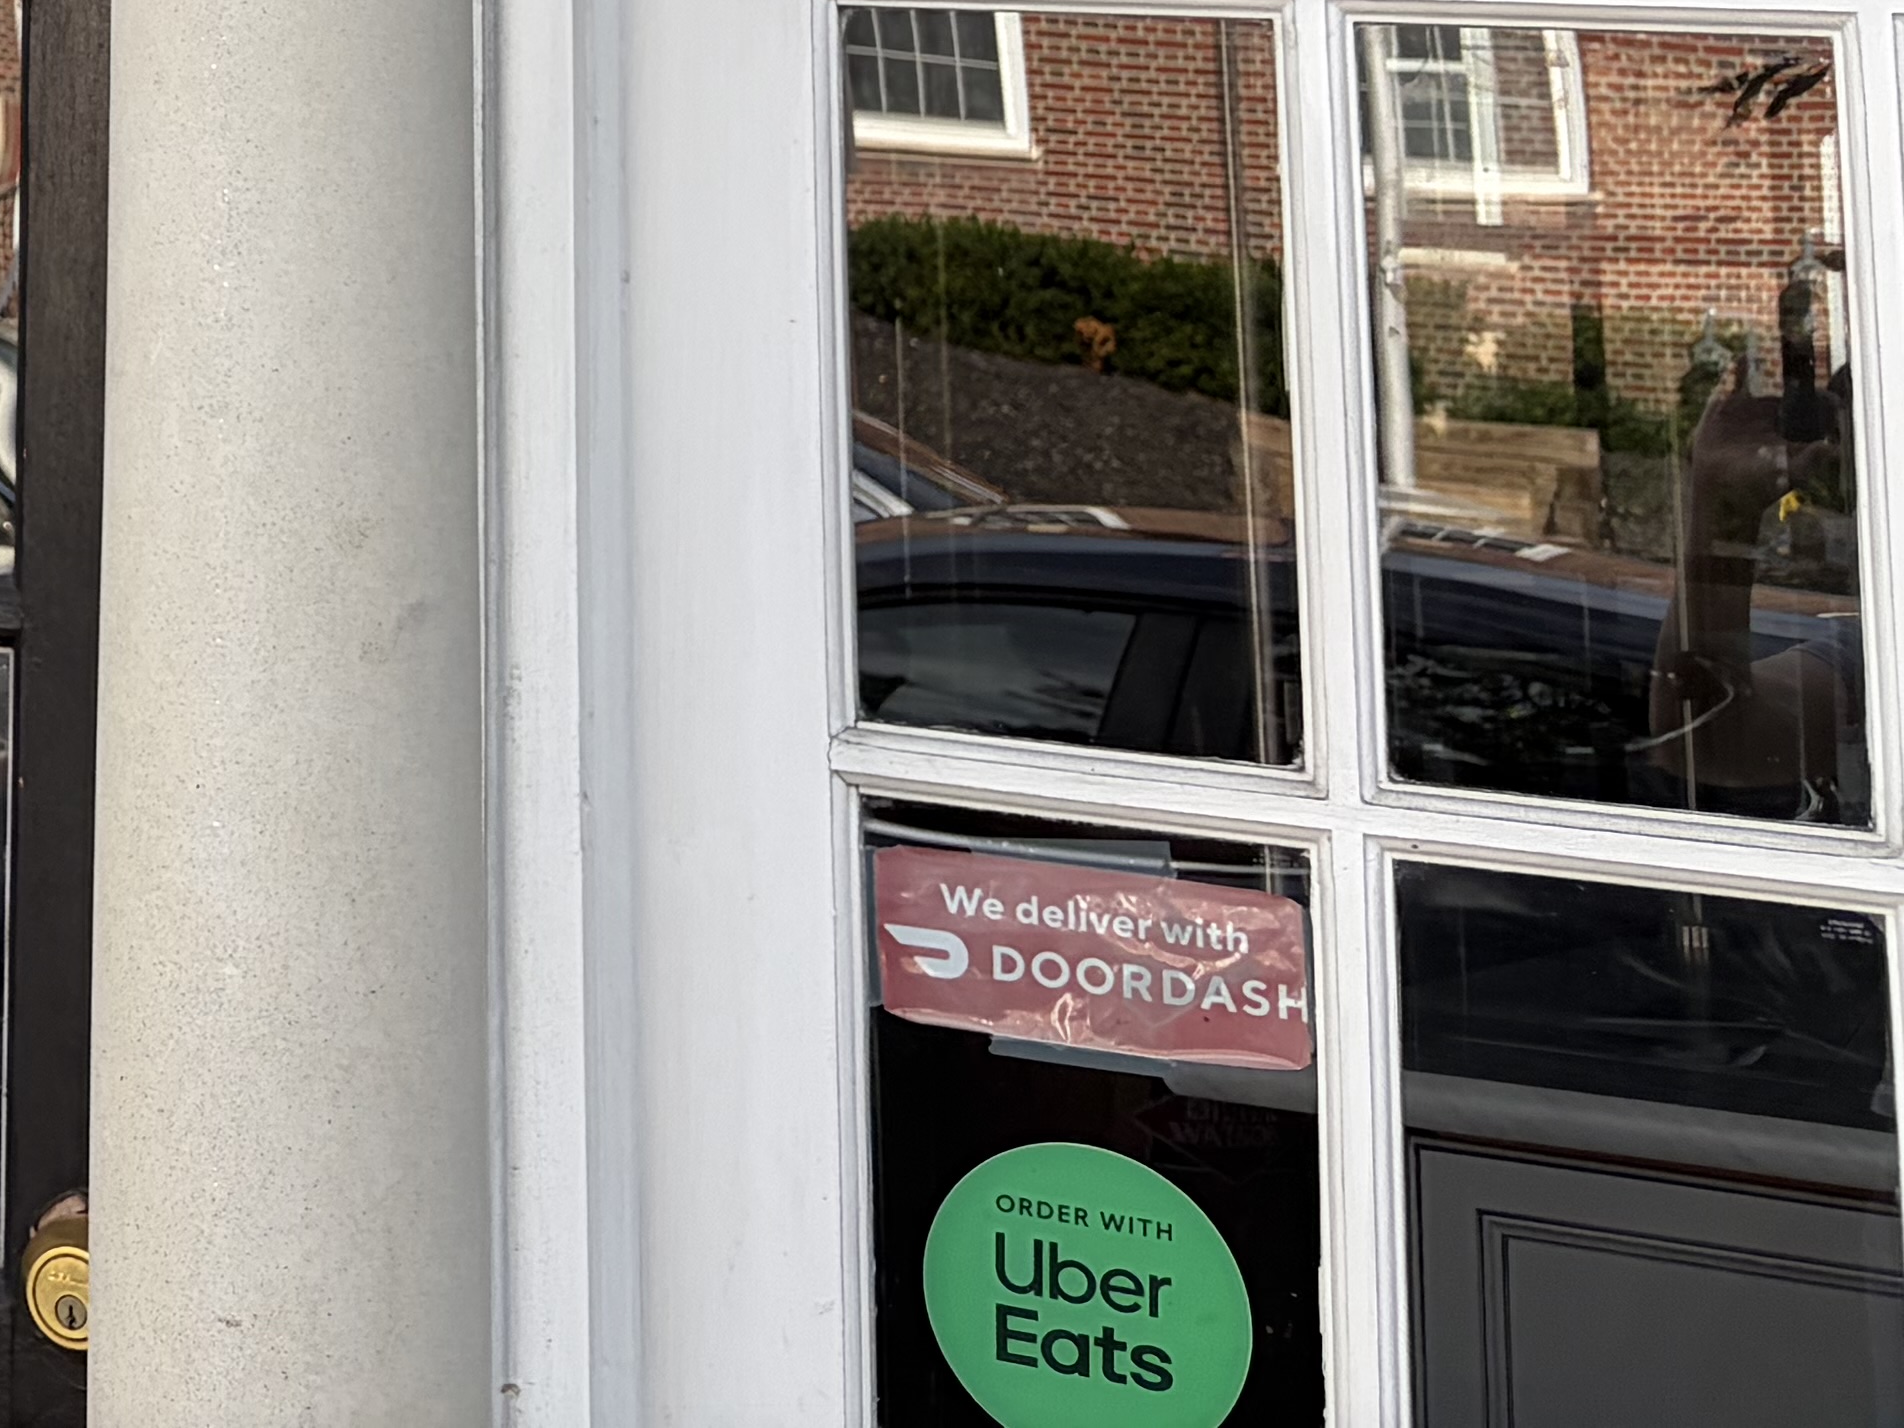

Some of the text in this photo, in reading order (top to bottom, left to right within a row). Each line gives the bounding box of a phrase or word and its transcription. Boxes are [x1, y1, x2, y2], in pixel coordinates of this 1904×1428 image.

[940, 883, 1249, 954] We deliver with
[993, 945, 1308, 1024] DOORDASH
[995, 1194, 1173, 1242] ORDER WITH
[995, 1231, 1173, 1318] Uber
[995, 1302, 1174, 1392] Eats
